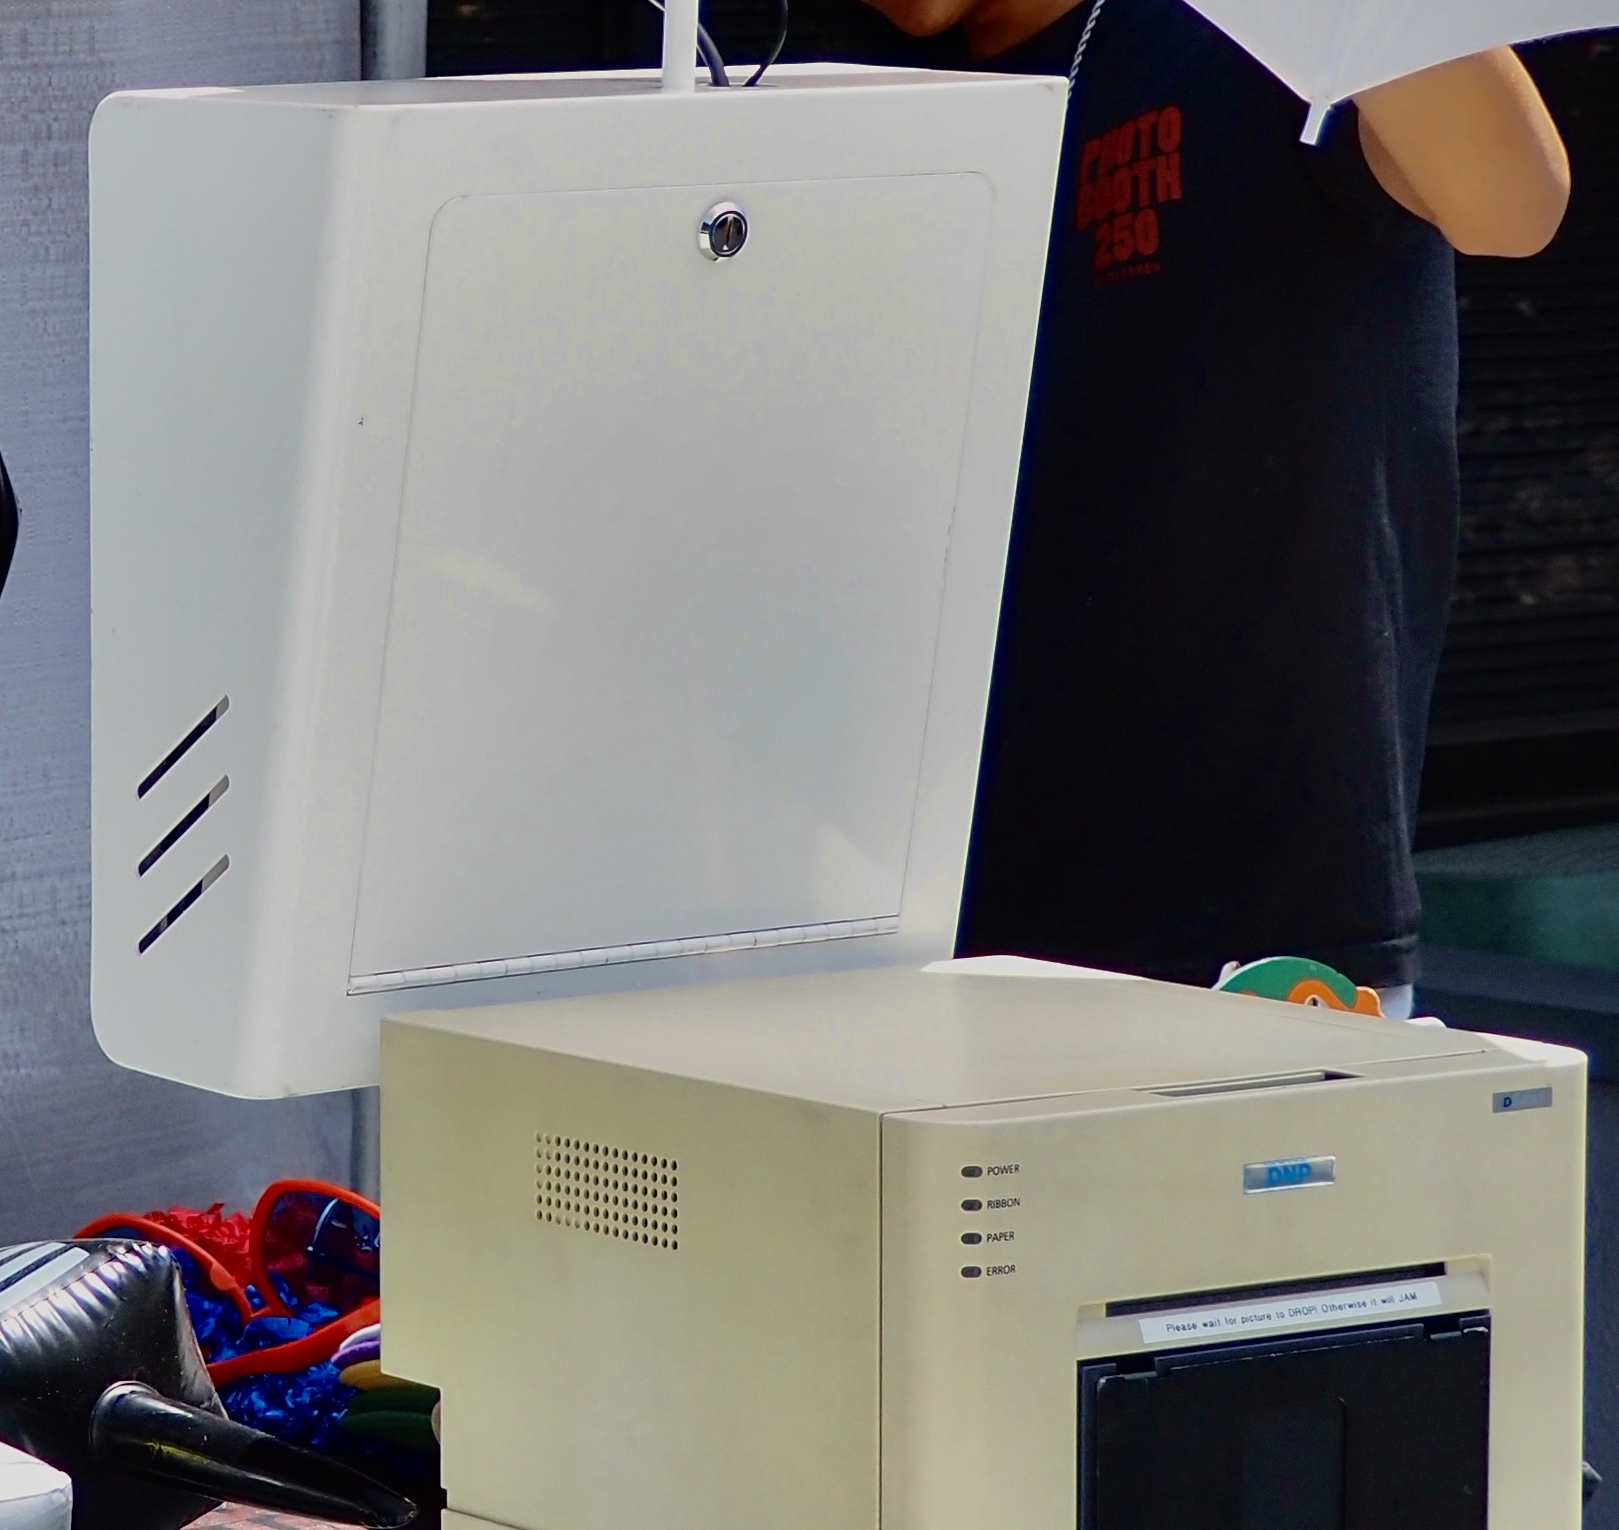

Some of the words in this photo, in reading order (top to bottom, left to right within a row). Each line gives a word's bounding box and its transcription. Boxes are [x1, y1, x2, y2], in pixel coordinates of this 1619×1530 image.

[1094, 207, 1160, 269] 250
[986, 1163, 1021, 1177] POWER
[1267, 1162, 1313, 1186] DNP
[986, 1197, 1021, 1210] RIBBON
[986, 1231, 1016, 1244] PAPER
[986, 1264, 1017, 1277] ERROR
[1165, 1321, 1198, 1333] Please
[1201, 1318, 1221, 1328] wait
[1224, 1315, 1238, 1325] for
[1240, 1312, 1273, 1325] picture
[1275, 1309, 1286, 1319] to
[1288, 1305, 1318, 1318] DROP!
[1320, 1299, 1368, 1314] Otherwise
[1370, 1297, 1378, 1307] it
[1380, 1294, 1395, 1305] will
[1398, 1290, 1418, 1303] JAM
